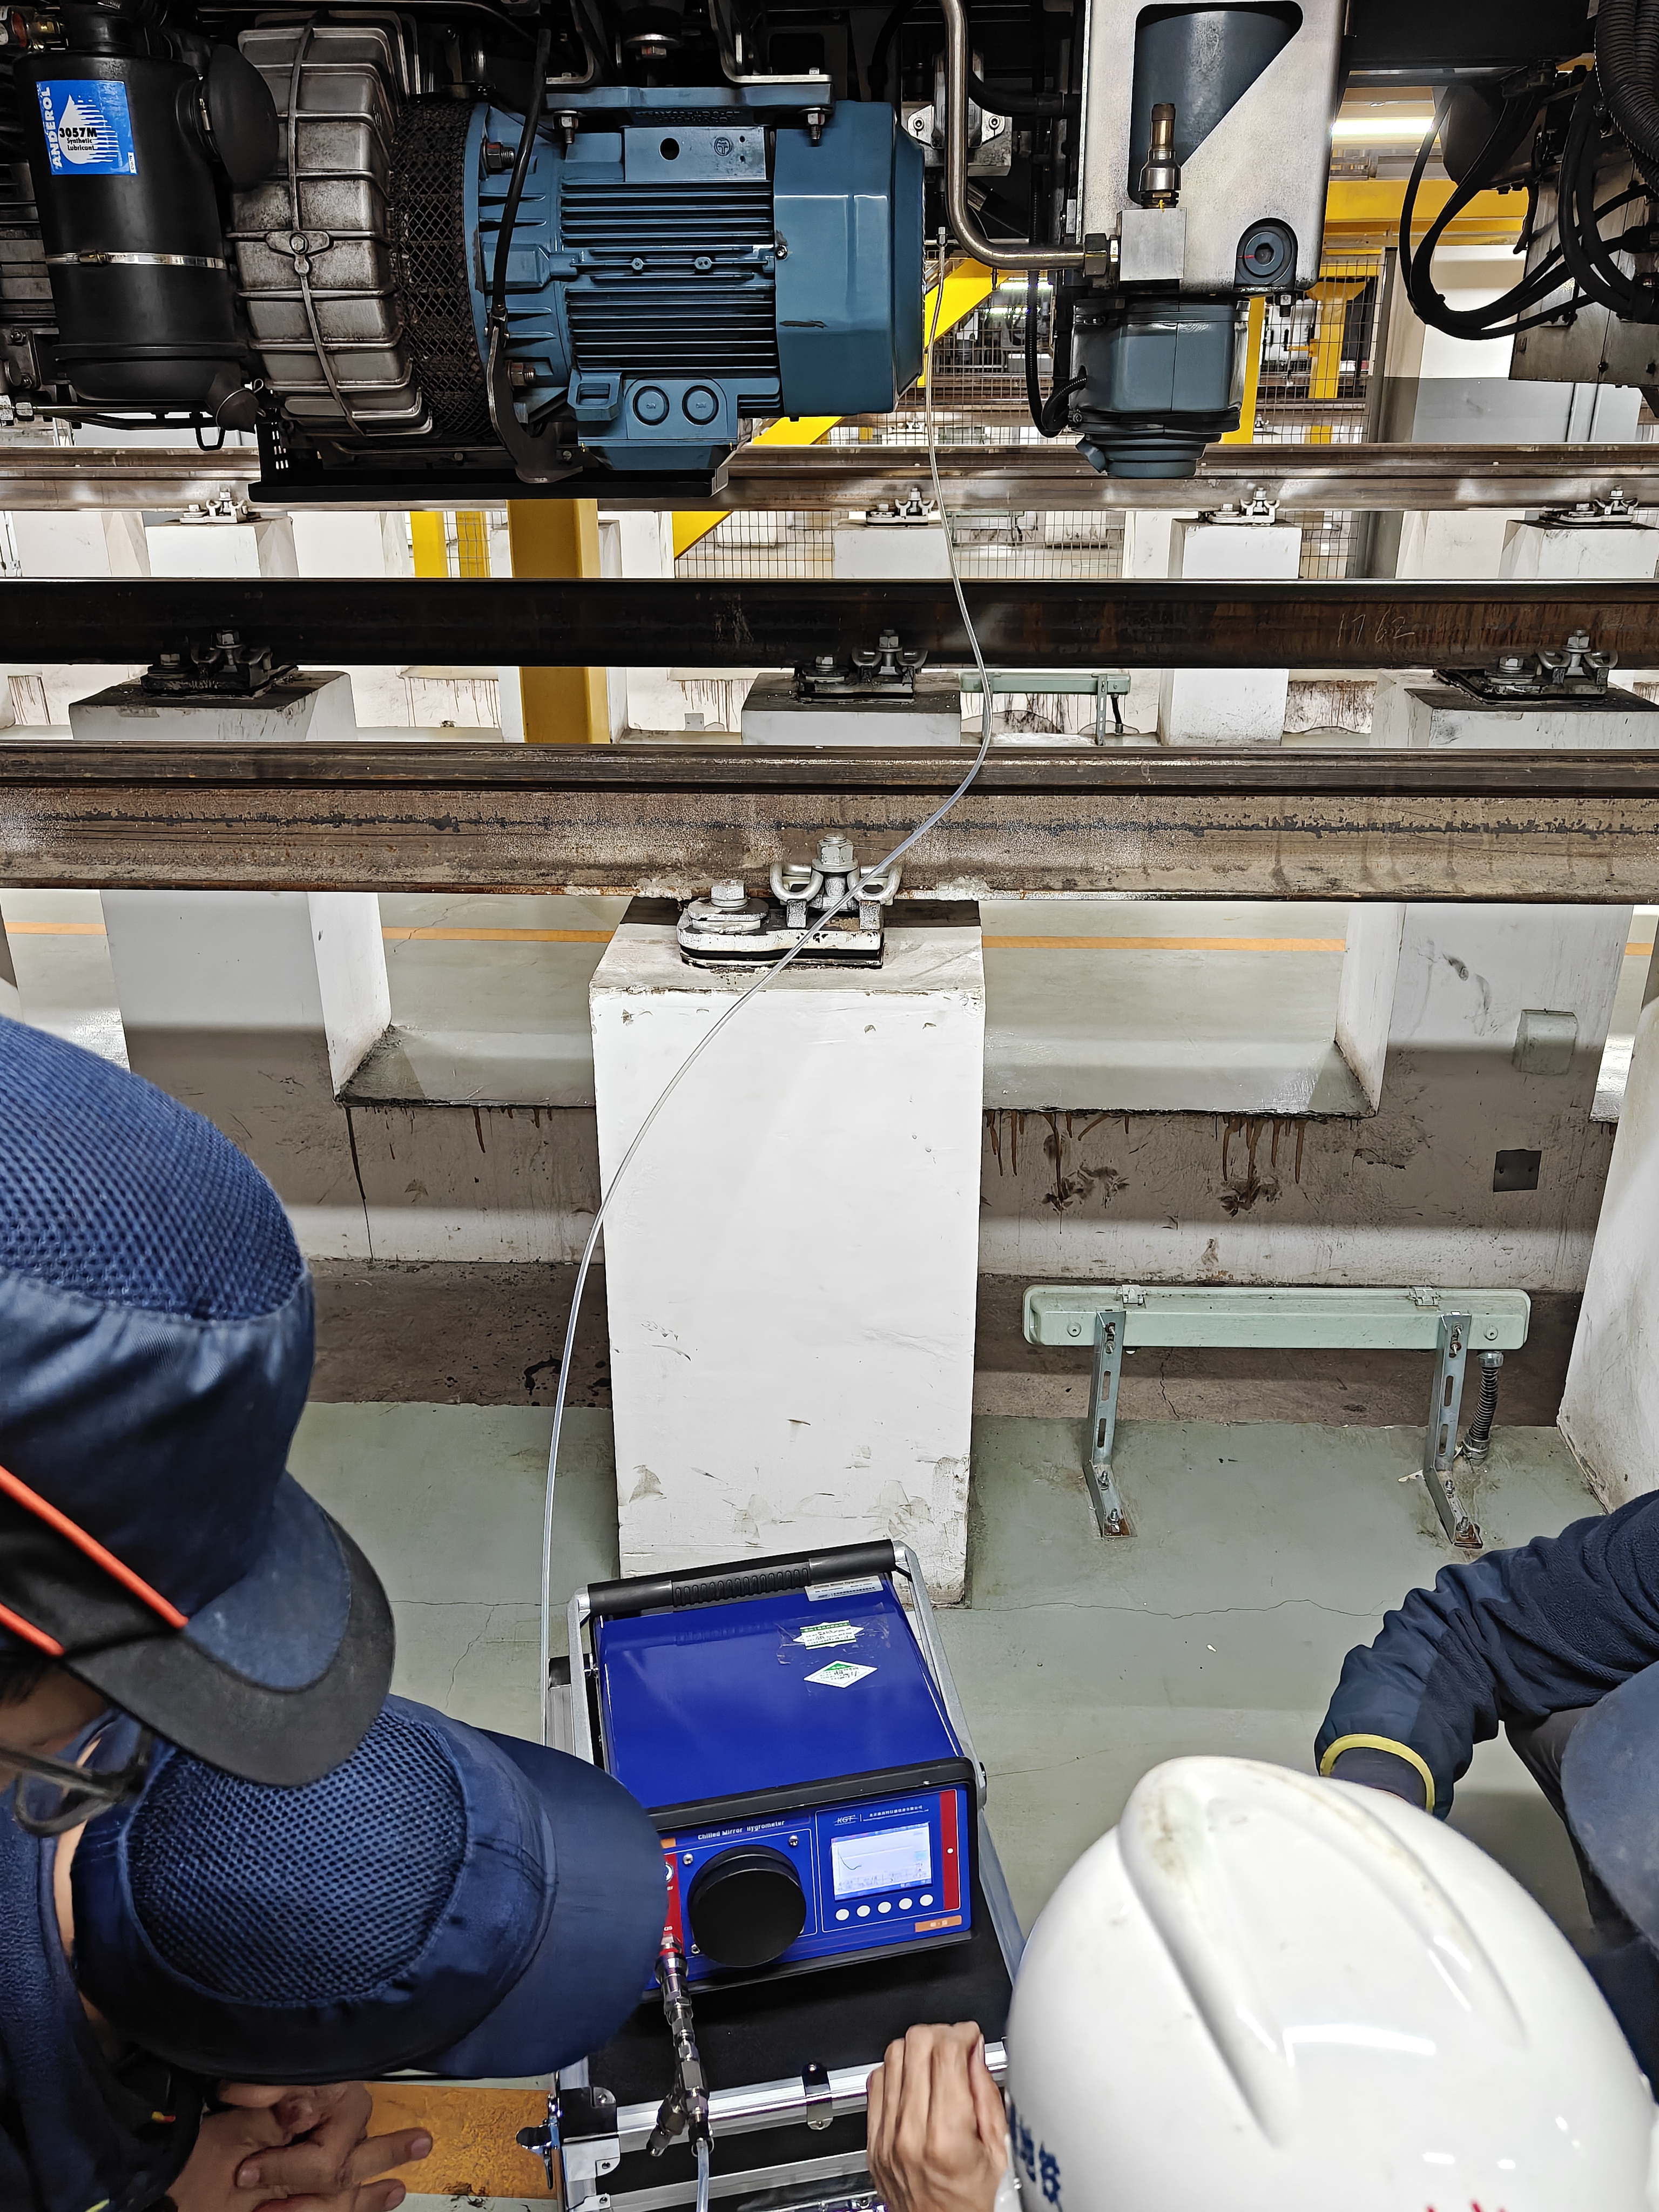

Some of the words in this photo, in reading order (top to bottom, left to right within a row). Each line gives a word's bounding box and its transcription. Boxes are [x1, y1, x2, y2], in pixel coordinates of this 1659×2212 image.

[41, 86, 63, 168] ANDEROL
[59, 127, 97, 138] 3057M
[697, 1830, 720, 1840] Chilled
[722, 1827, 743, 1836] Mirror
[746, 1820, 785, 1832] Hygrometer
